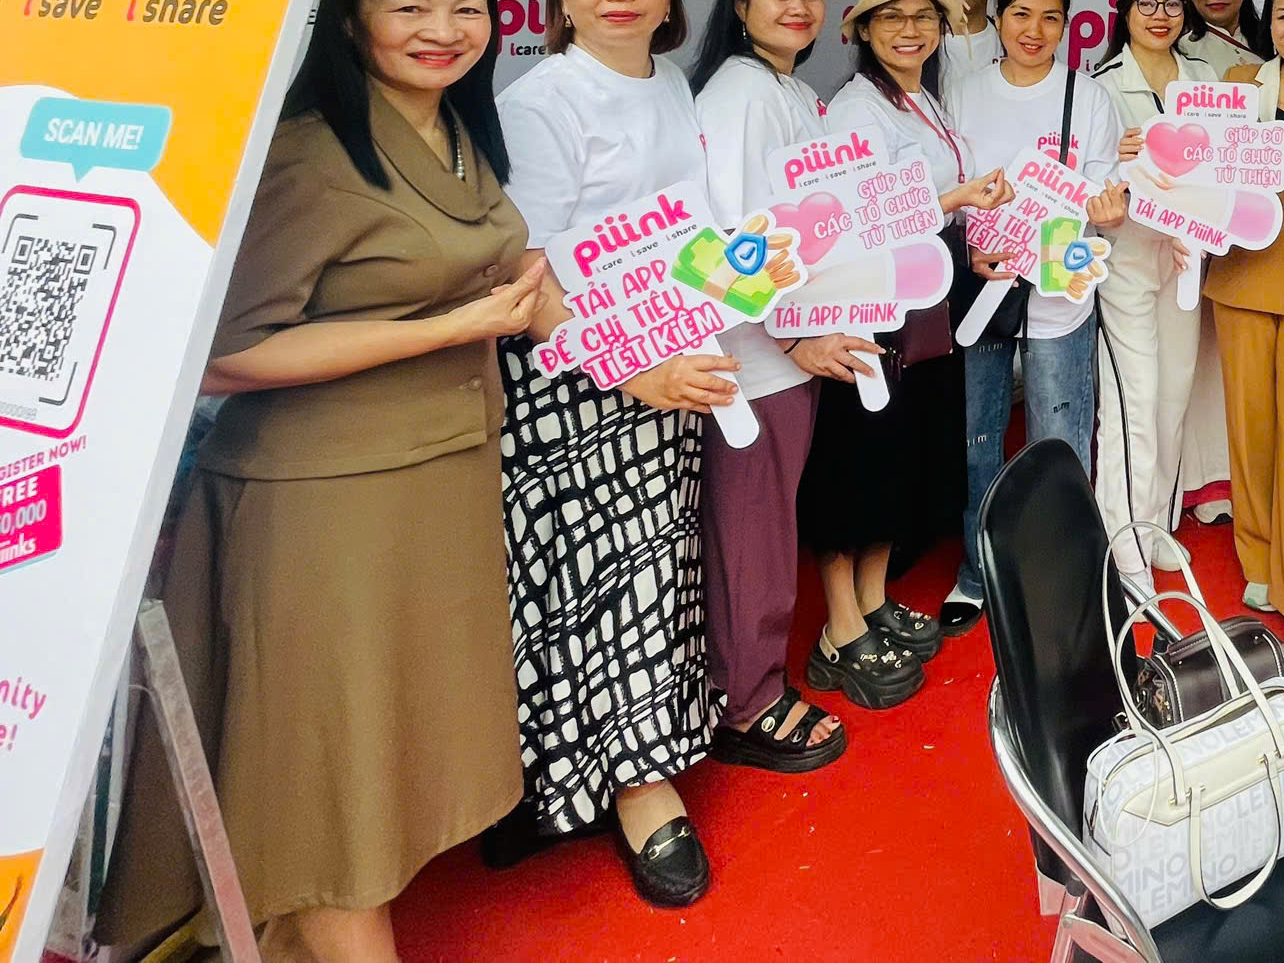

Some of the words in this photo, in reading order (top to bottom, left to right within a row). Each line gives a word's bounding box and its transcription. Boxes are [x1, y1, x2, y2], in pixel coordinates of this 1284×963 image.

[1176, 84, 1247, 116] piiink
[44, 117, 101, 149] SCAN
[103, 124, 145, 150] ME!
[784, 132, 874, 190] piiink
[1183, 142, 1214, 162] CÁC
[1217, 142, 1239, 163] TỔ
[1240, 145, 1282, 166] CHỨC
[803, 177, 820, 187] care
[857, 160, 877, 171] share
[1017, 161, 1089, 209] piiink
[813, 212, 853, 240] CÁC
[855, 197, 881, 226] TỔ
[884, 187, 932, 216] CHỨC
[1016, 197, 1049, 222] APP
[1157, 209, 1185, 230] APP
[572, 193, 693, 279] piiink
[602, 256, 624, 272] care
[636, 240, 659, 256] save
[671, 223, 698, 239] share
[859, 223, 886, 250] TỪ
[621, 259, 667, 300] APP
[808, 305, 843, 327] APP
[537, 328, 577, 373] ĐỂ
[49, 435, 87, 463] NOW!
